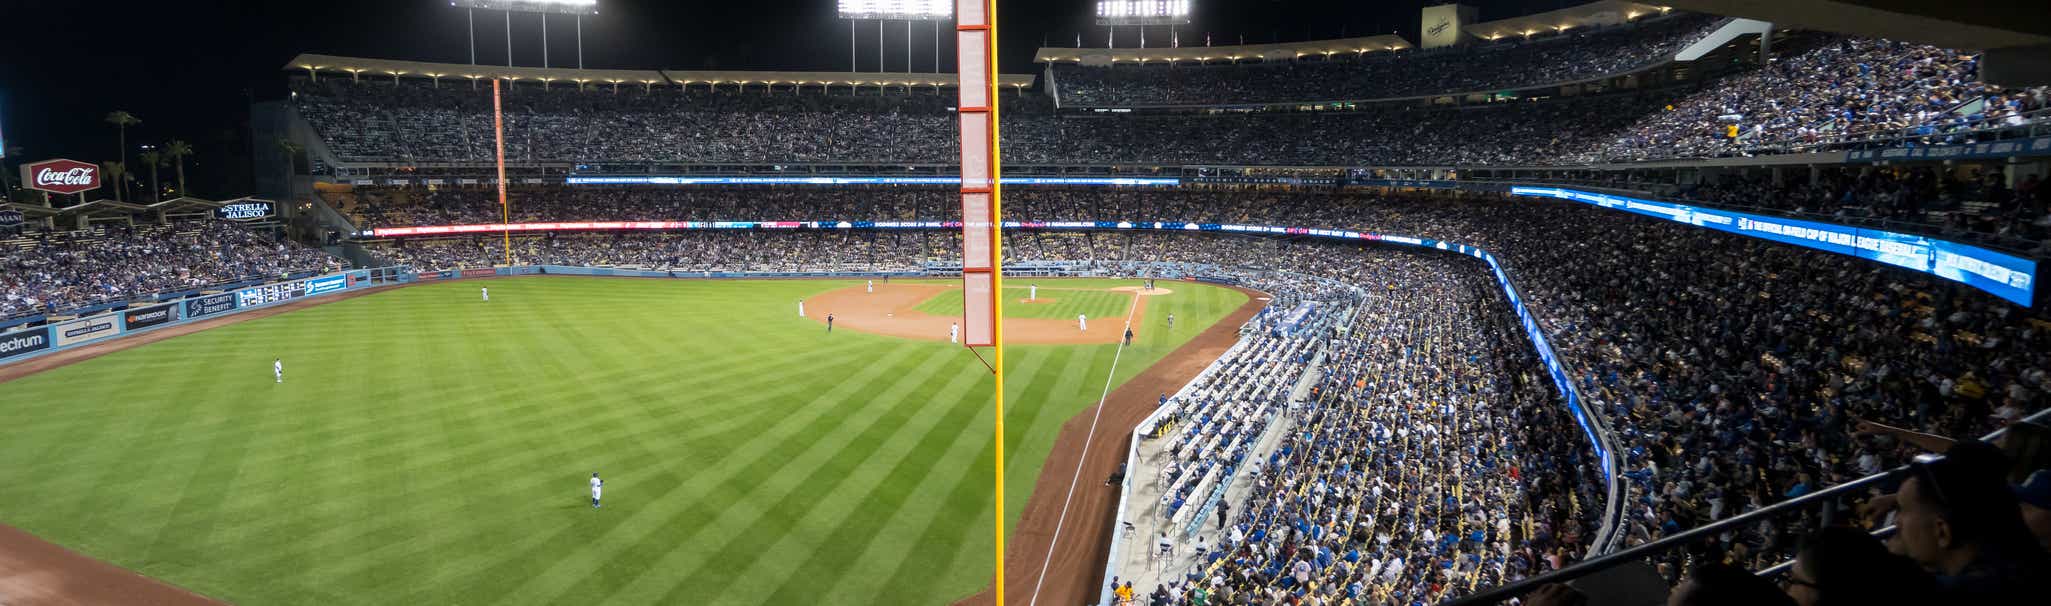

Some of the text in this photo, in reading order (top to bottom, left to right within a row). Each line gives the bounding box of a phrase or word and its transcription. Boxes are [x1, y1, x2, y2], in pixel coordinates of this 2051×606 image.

[37, 167, 94, 186] Coca-Cola
[221, 203, 269, 212] ESTRELLA
[226, 210, 265, 219] JALISCO
[203, 295, 233, 306] SECURITY
[203, 303, 230, 314] BENEFIT
[0, 335, 42, 353] ectrum
